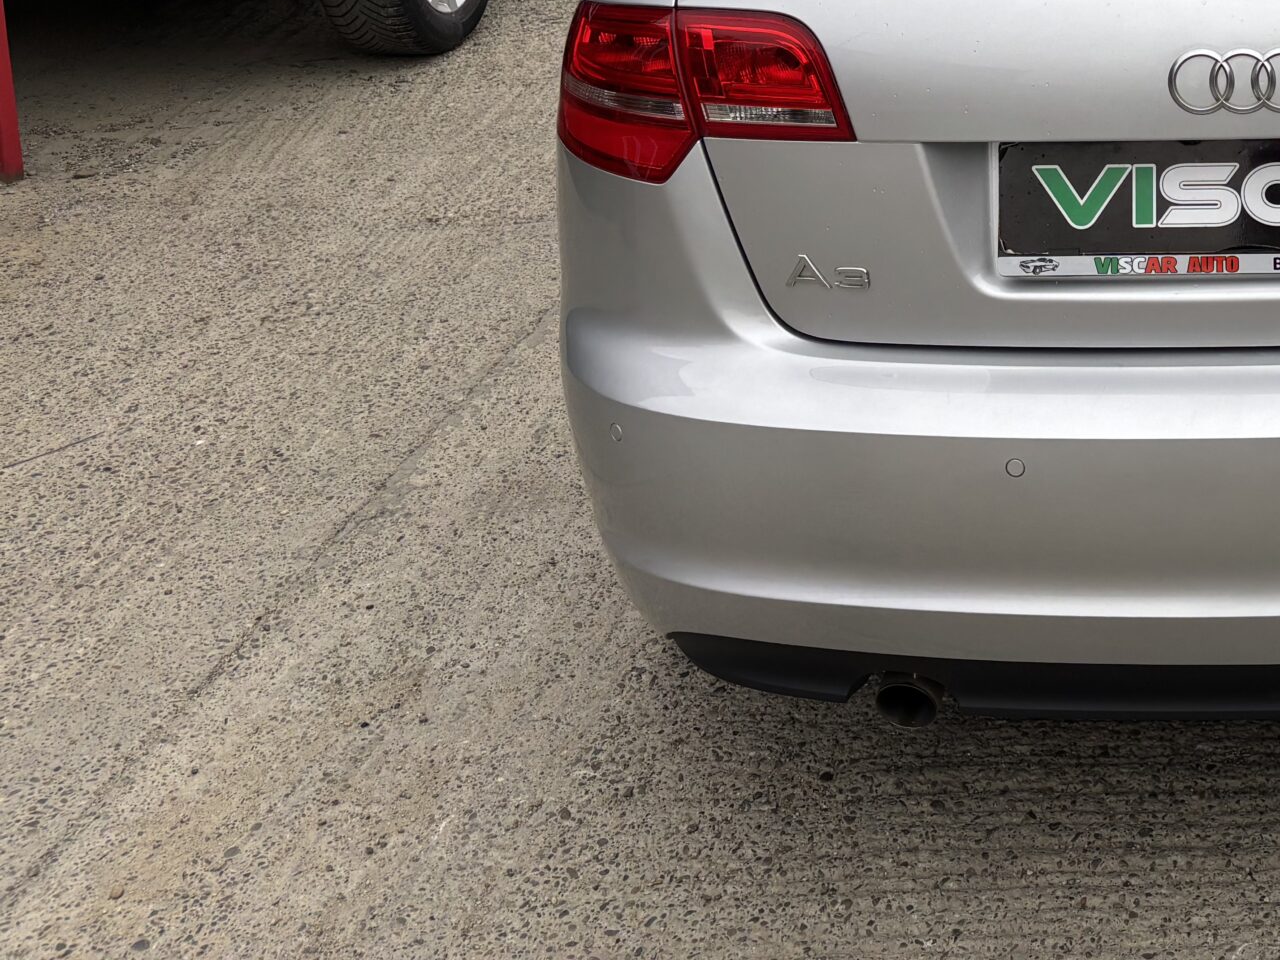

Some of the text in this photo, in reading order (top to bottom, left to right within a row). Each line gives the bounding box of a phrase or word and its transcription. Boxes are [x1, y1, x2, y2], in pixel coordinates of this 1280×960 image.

[785, 253, 871, 290] A3
[1093, 256, 1178, 275] VISCAR
[1187, 255, 1240, 274] AUTO
